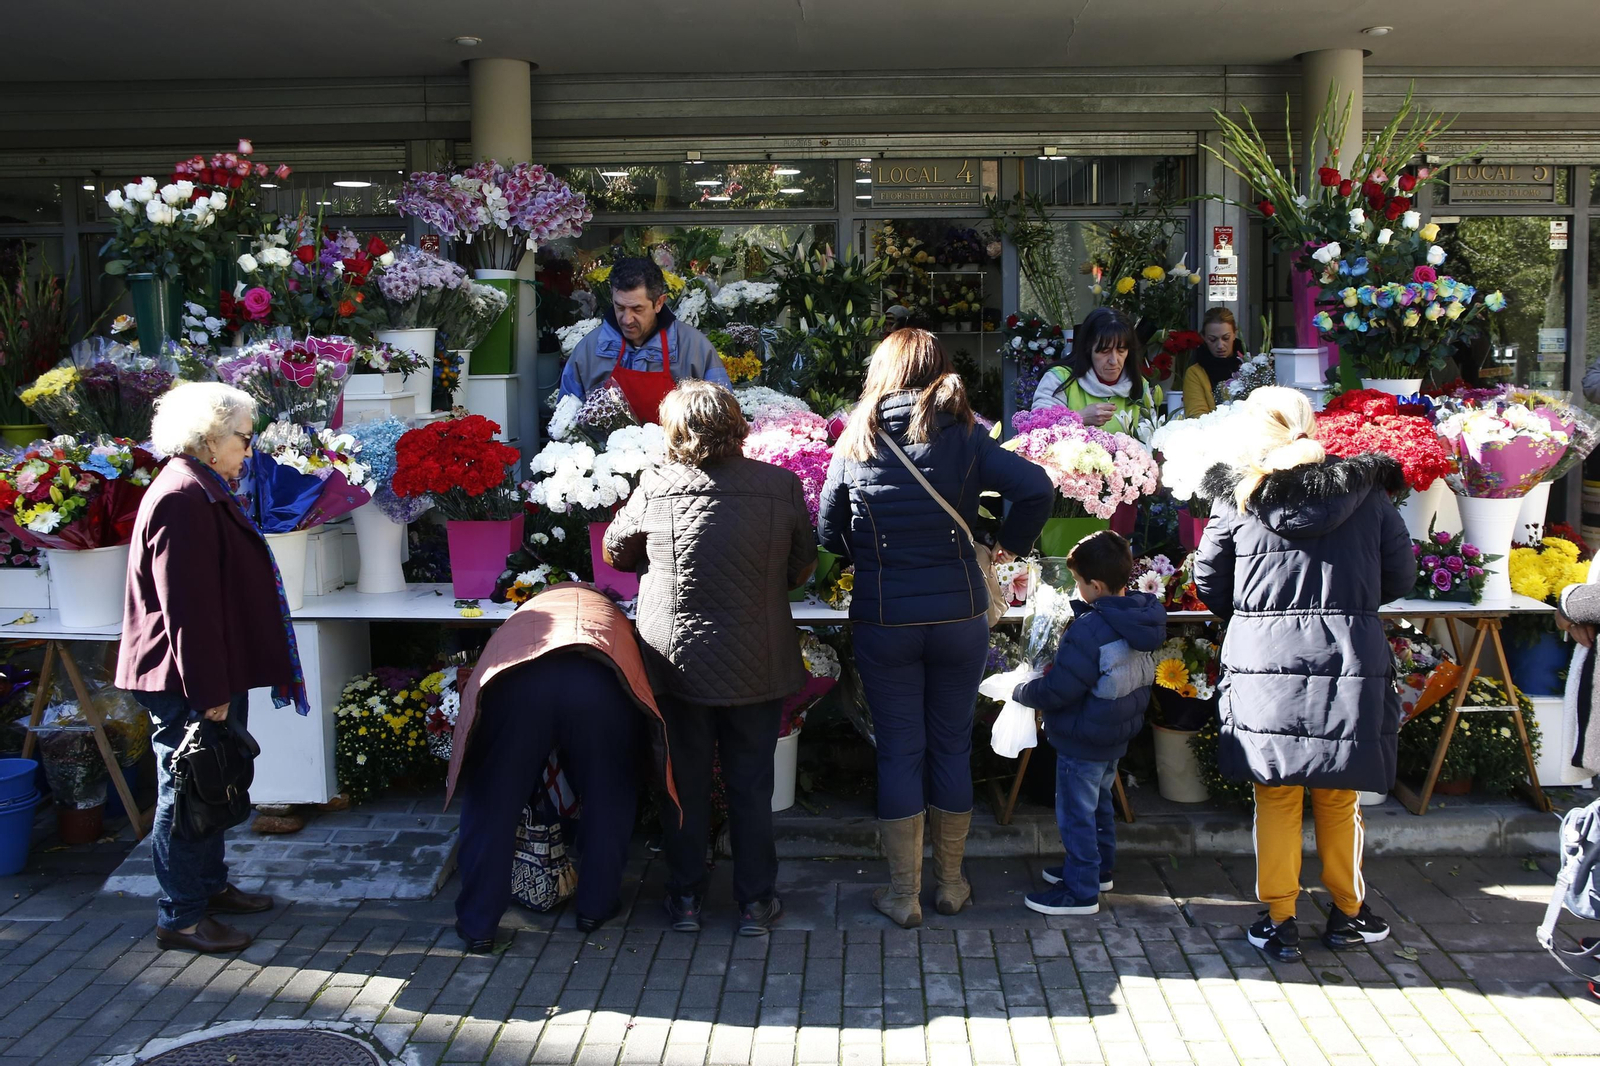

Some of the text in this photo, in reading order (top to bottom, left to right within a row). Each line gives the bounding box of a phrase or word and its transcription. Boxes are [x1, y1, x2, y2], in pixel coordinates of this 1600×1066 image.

[877, 160, 974, 183] LOCAL 4
[1456, 165, 1521, 180] LOCAL
